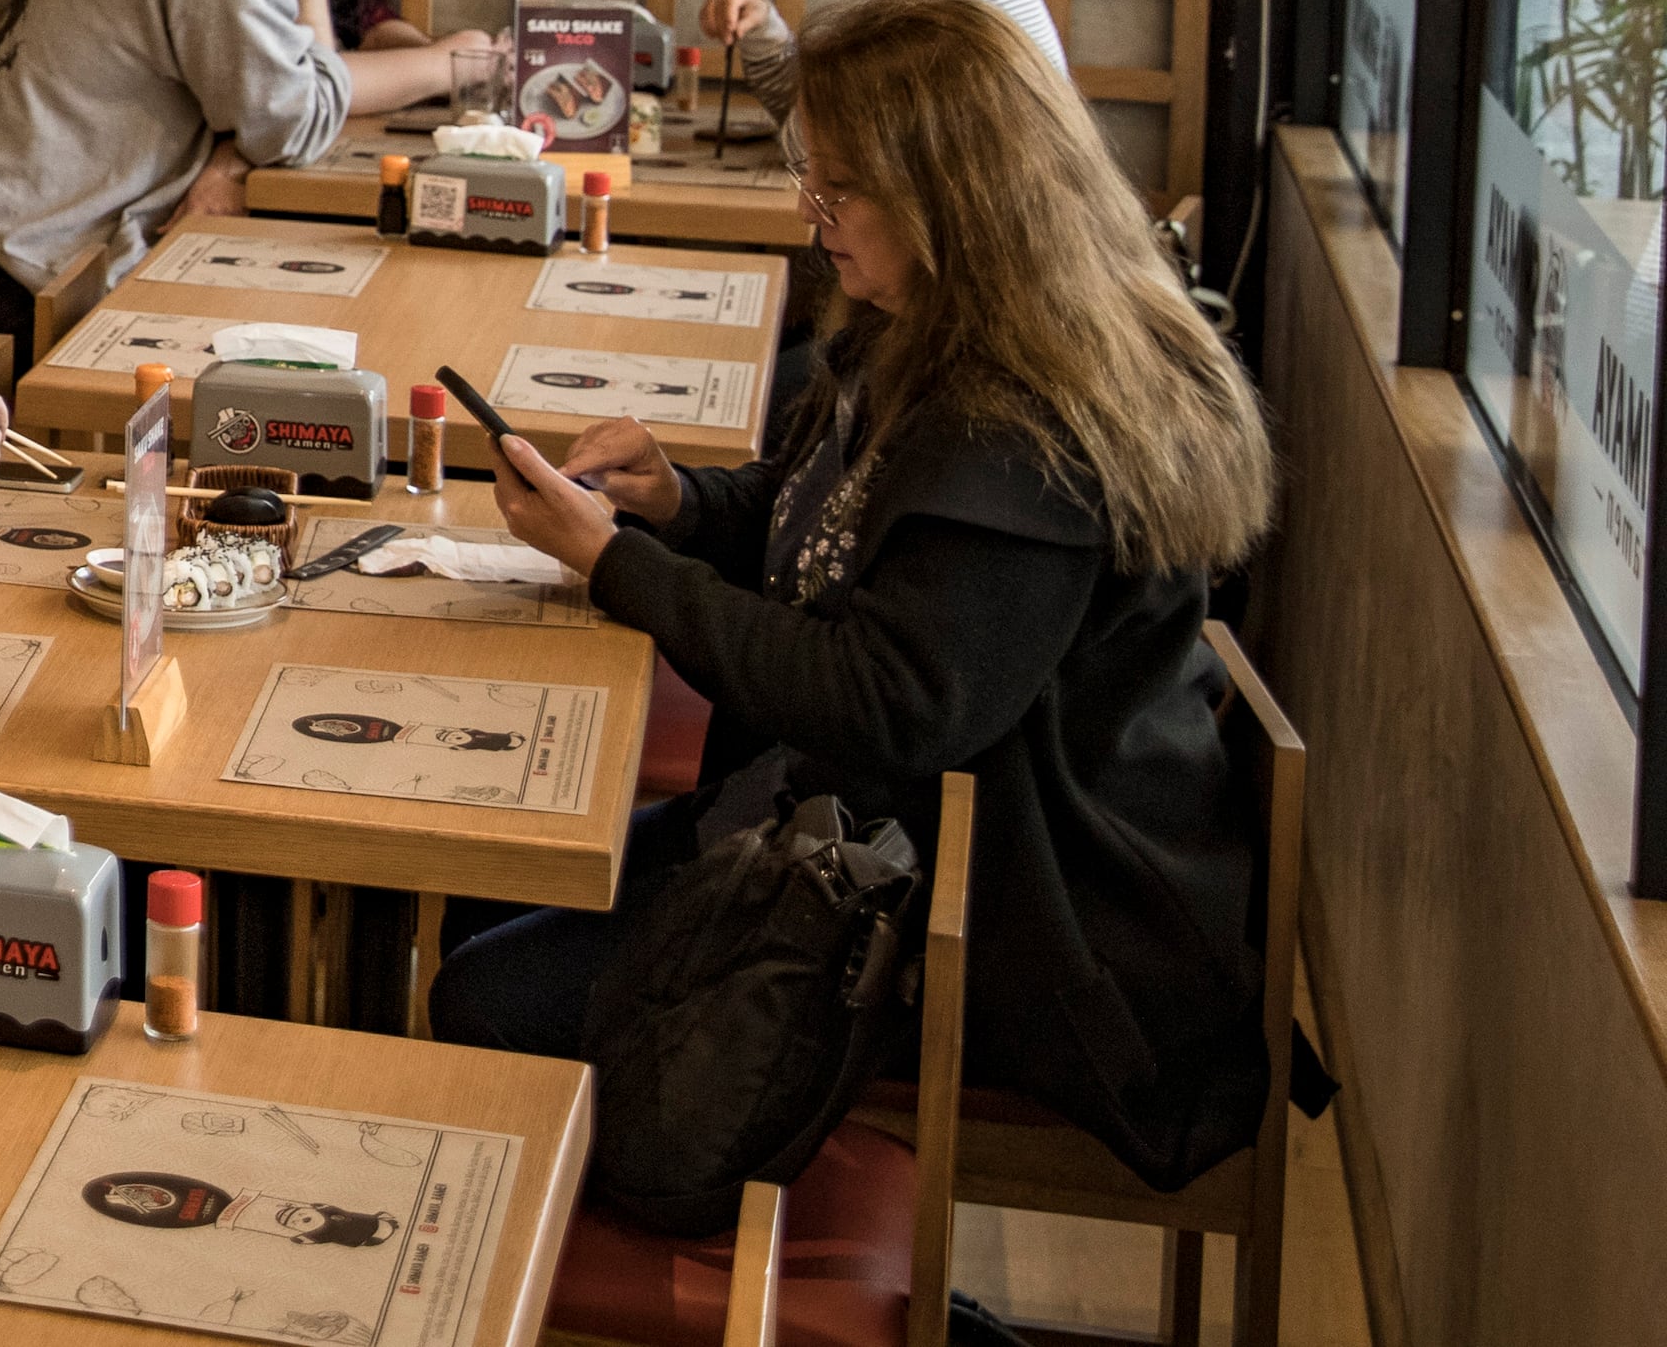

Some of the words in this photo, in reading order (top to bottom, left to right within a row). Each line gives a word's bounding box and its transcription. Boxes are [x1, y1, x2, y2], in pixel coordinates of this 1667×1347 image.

[527, 19, 570, 33] SAKU
[572, 20, 624, 34] SHAKE
[555, 33, 596, 46] TACO
[468, 196, 533, 217] SHIMAYA
[268, 422, 353, 444] SHIMAYA
[287, 438, 332, 450] ramen
